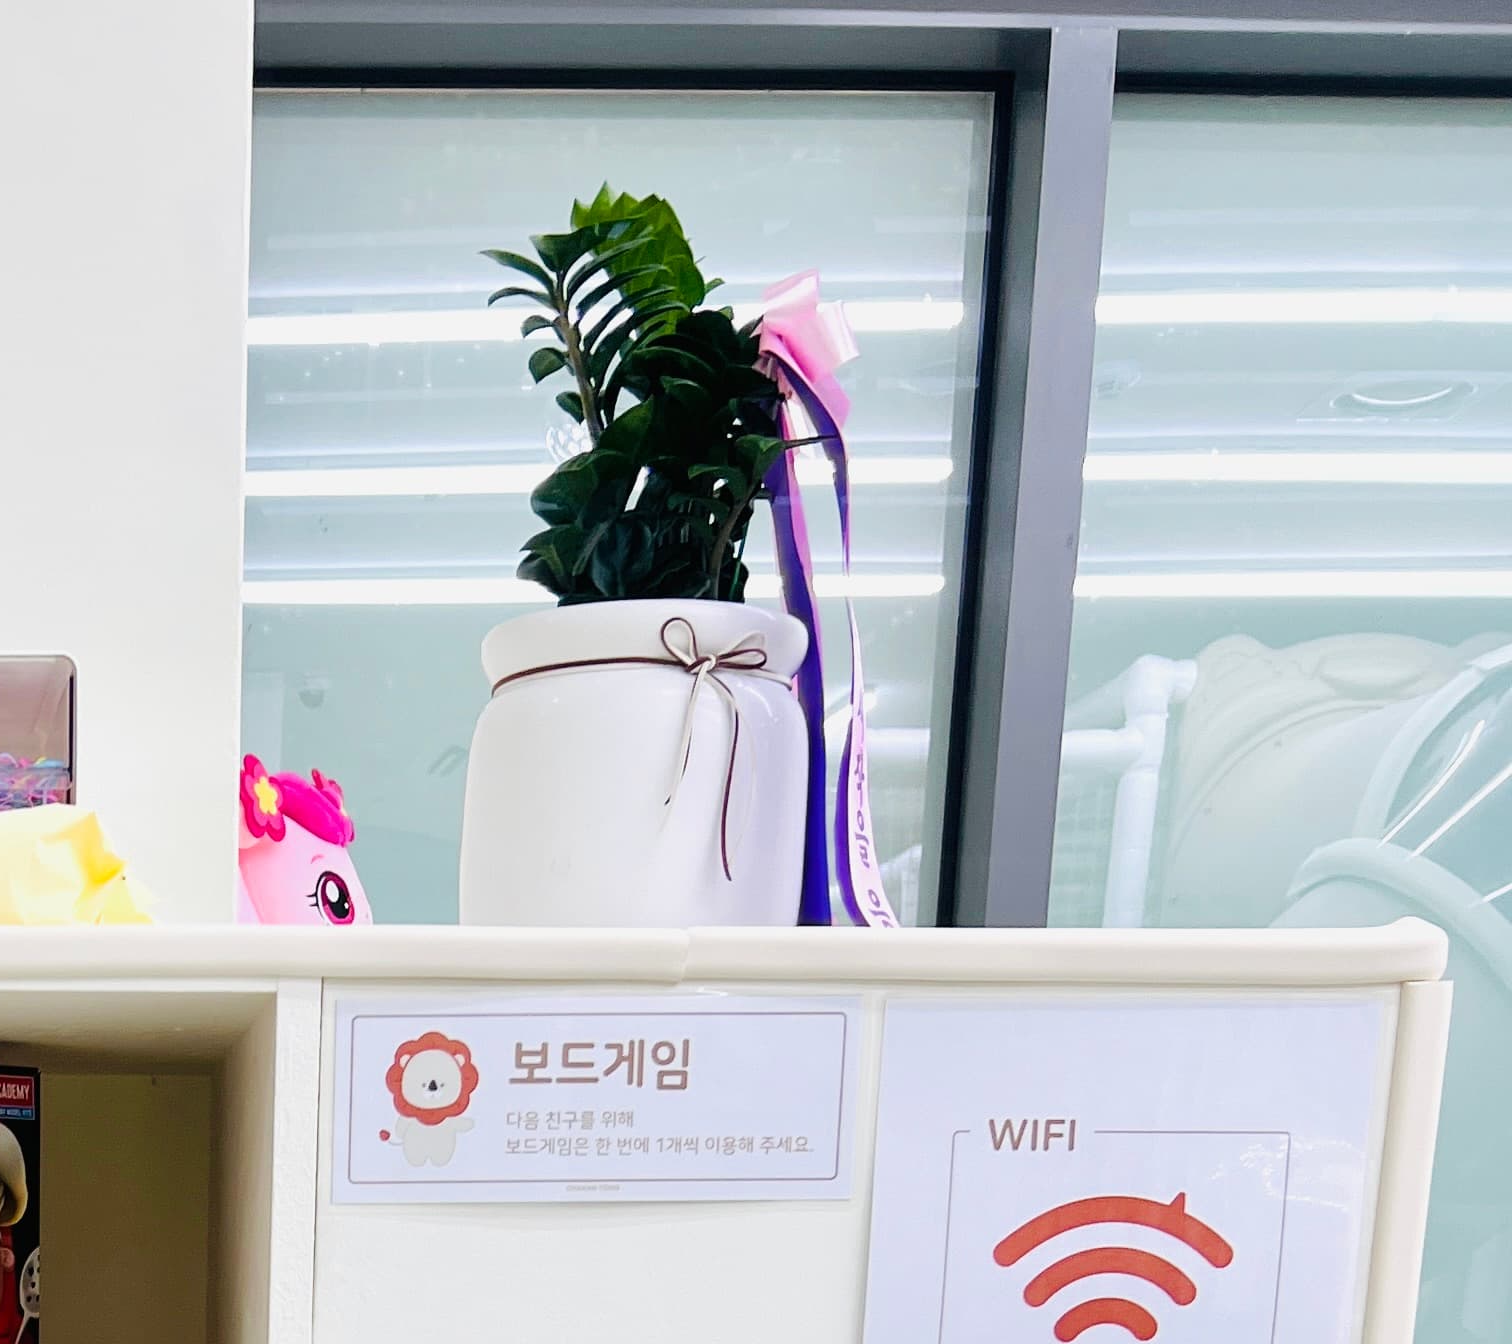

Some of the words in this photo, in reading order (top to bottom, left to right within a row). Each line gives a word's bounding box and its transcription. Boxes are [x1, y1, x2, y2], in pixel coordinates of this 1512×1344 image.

[508, 1038, 691, 1091] 보드게임
[505, 1111, 539, 1130] 다음
[545, 1110, 596, 1130] 친구를
[601, 1110, 635, 1129] 위해
[504, 1137, 588, 1157] 보드게임은
[595, 1137, 611, 1156] 한
[617, 1137, 650, 1156] 번에
[656, 1136, 700, 1156] 1개씩
[705, 1136, 755, 1155] 이용해
[759, 1135, 815, 1155] 주세요.
[987, 1118, 1077, 1152] WIFI
